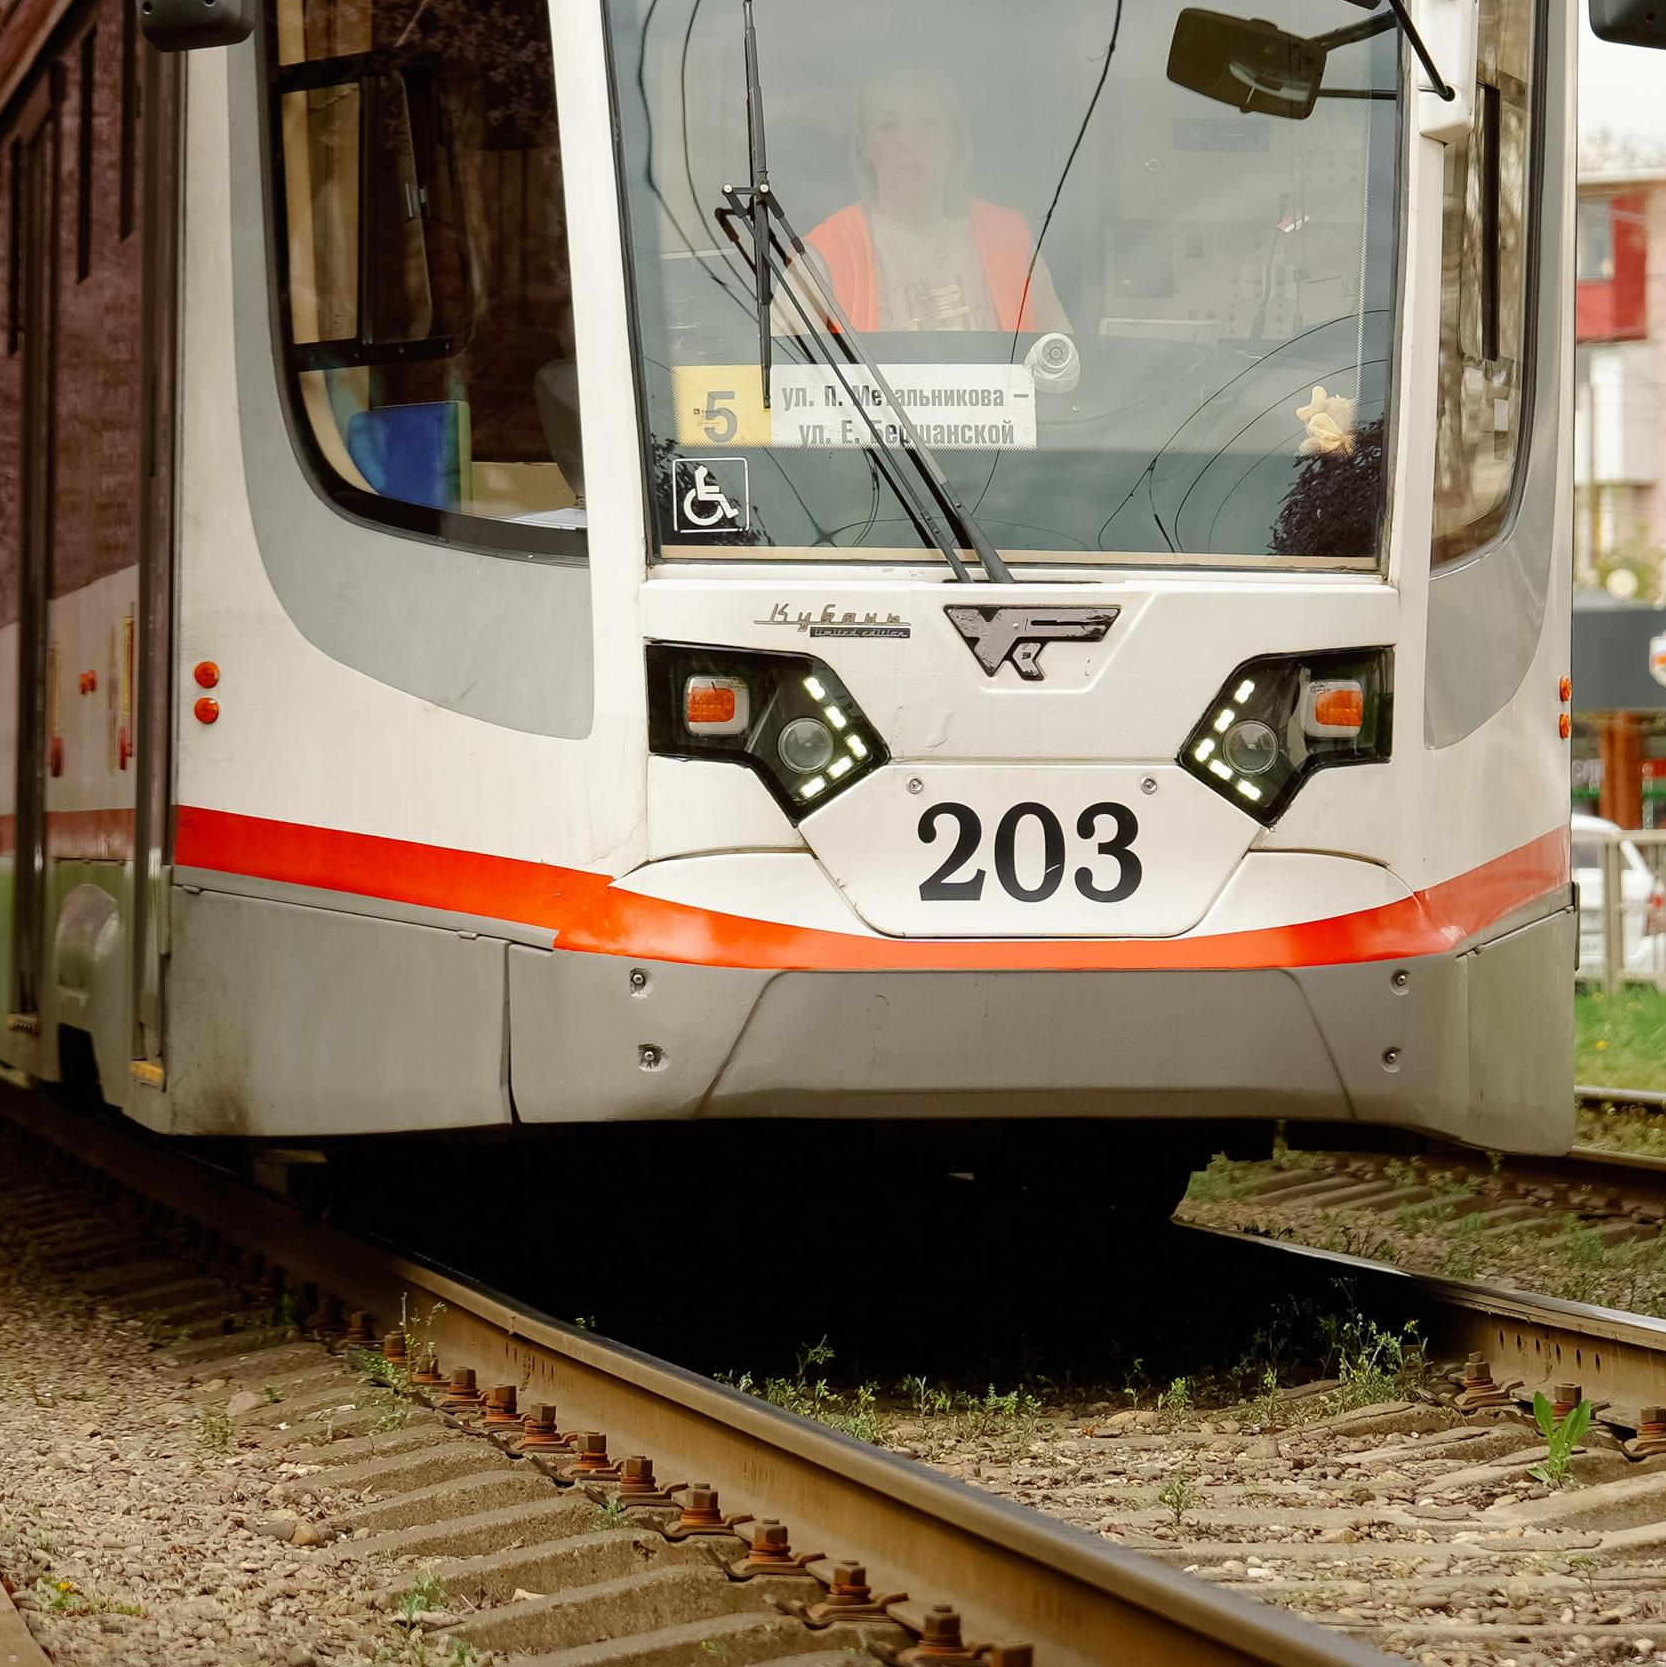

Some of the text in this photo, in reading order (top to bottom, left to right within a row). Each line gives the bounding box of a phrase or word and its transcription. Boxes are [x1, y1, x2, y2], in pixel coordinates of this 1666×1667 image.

[782, 386, 815, 412] ул.
[824, 385, 844, 407] П.
[852, 385, 1005, 407] Меальникова
[704, 390, 738, 443] 5
[799, 425, 832, 447] ул.
[841, 420, 860, 444] Е.
[769, 602, 903, 633] Кубань
[917, 801, 1143, 903] 203
